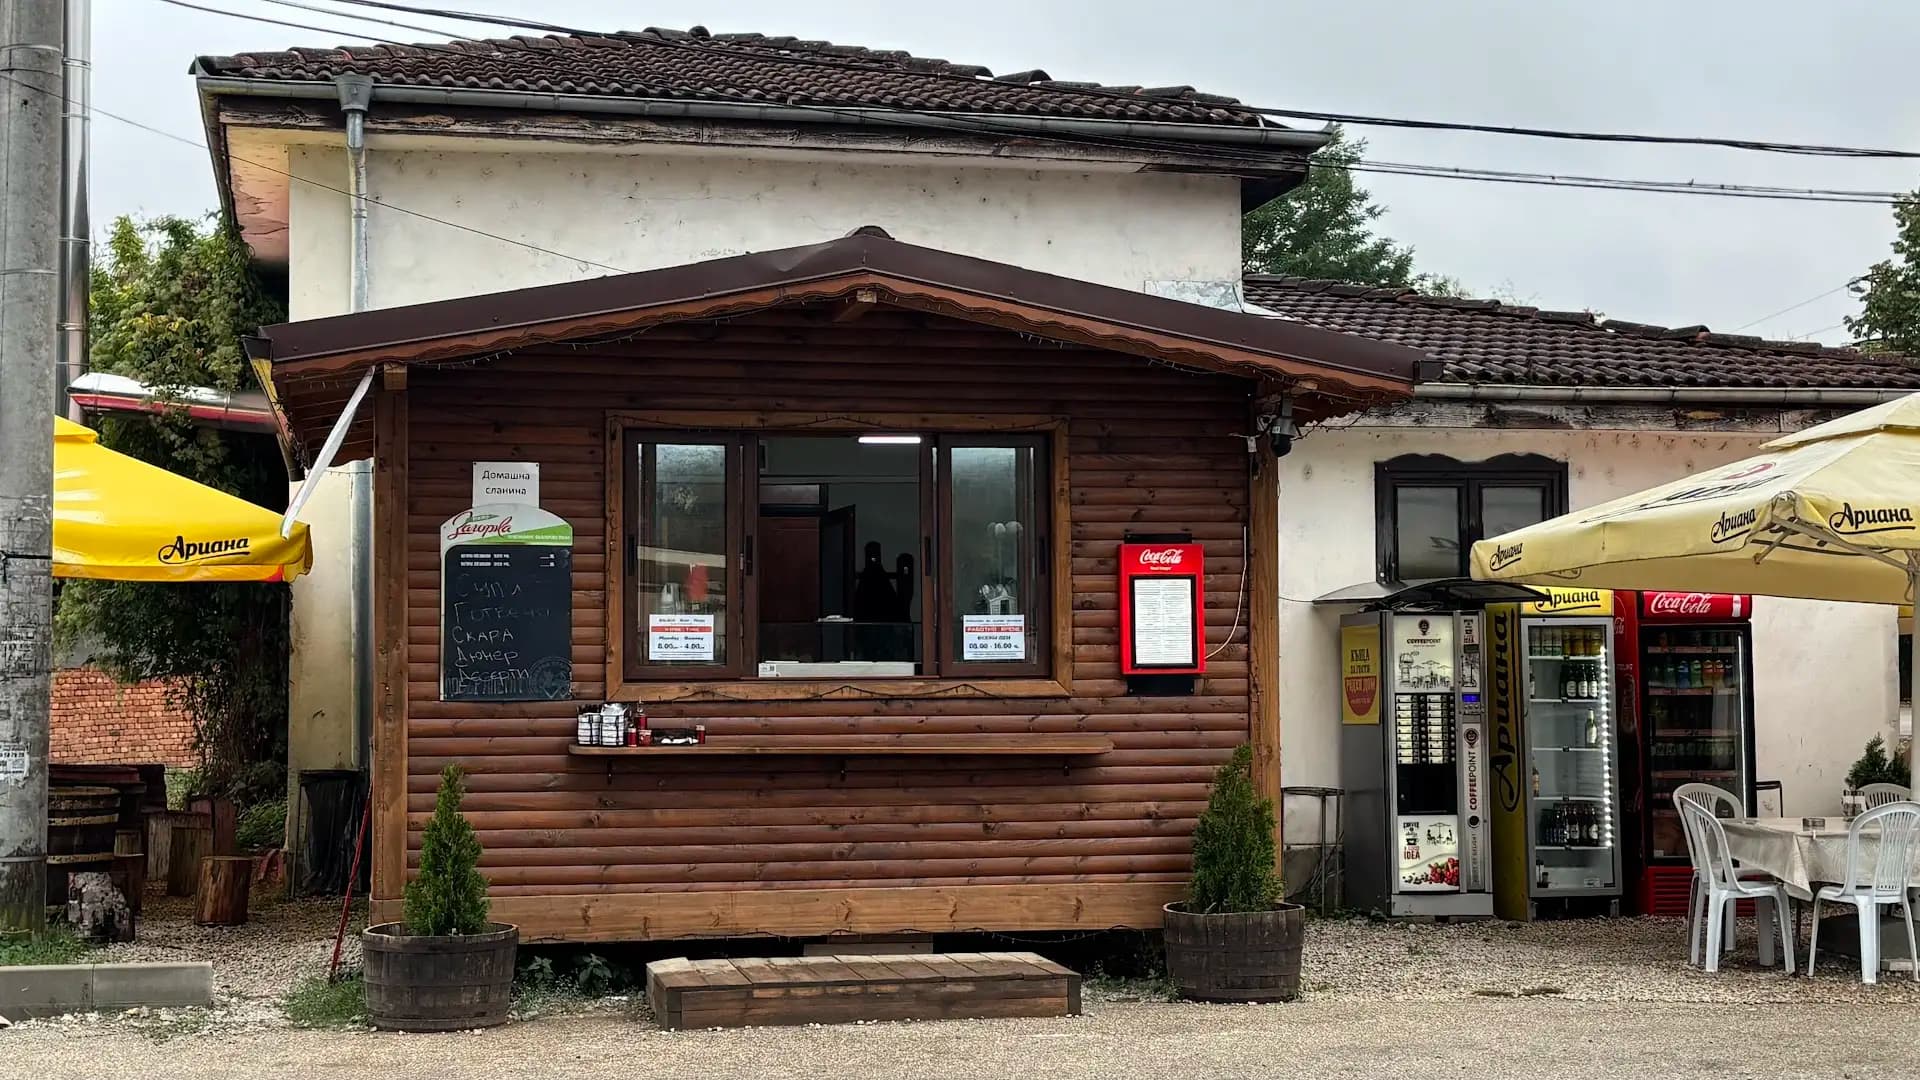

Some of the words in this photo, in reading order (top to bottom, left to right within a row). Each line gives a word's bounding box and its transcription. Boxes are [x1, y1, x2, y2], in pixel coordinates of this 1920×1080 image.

[482, 470, 530, 480] Домашна
[485, 486, 527, 495] сланина
[447, 511, 513, 540] Загорка
[1711, 508, 1757, 544] Ариана
[1829, 502, 1916, 535] Ариана
[158, 535, 250, 564] Ариана
[1139, 548, 1184, 565] Coca-Cola
[1490, 543, 1523, 571] Ариана
[1534, 588, 1602, 613] Ариана
[1650, 592, 1713, 614] Coca-Cola
[1490, 608, 1521, 812] Ариана
[1469, 751, 1478, 811] COFFEEPOINT
